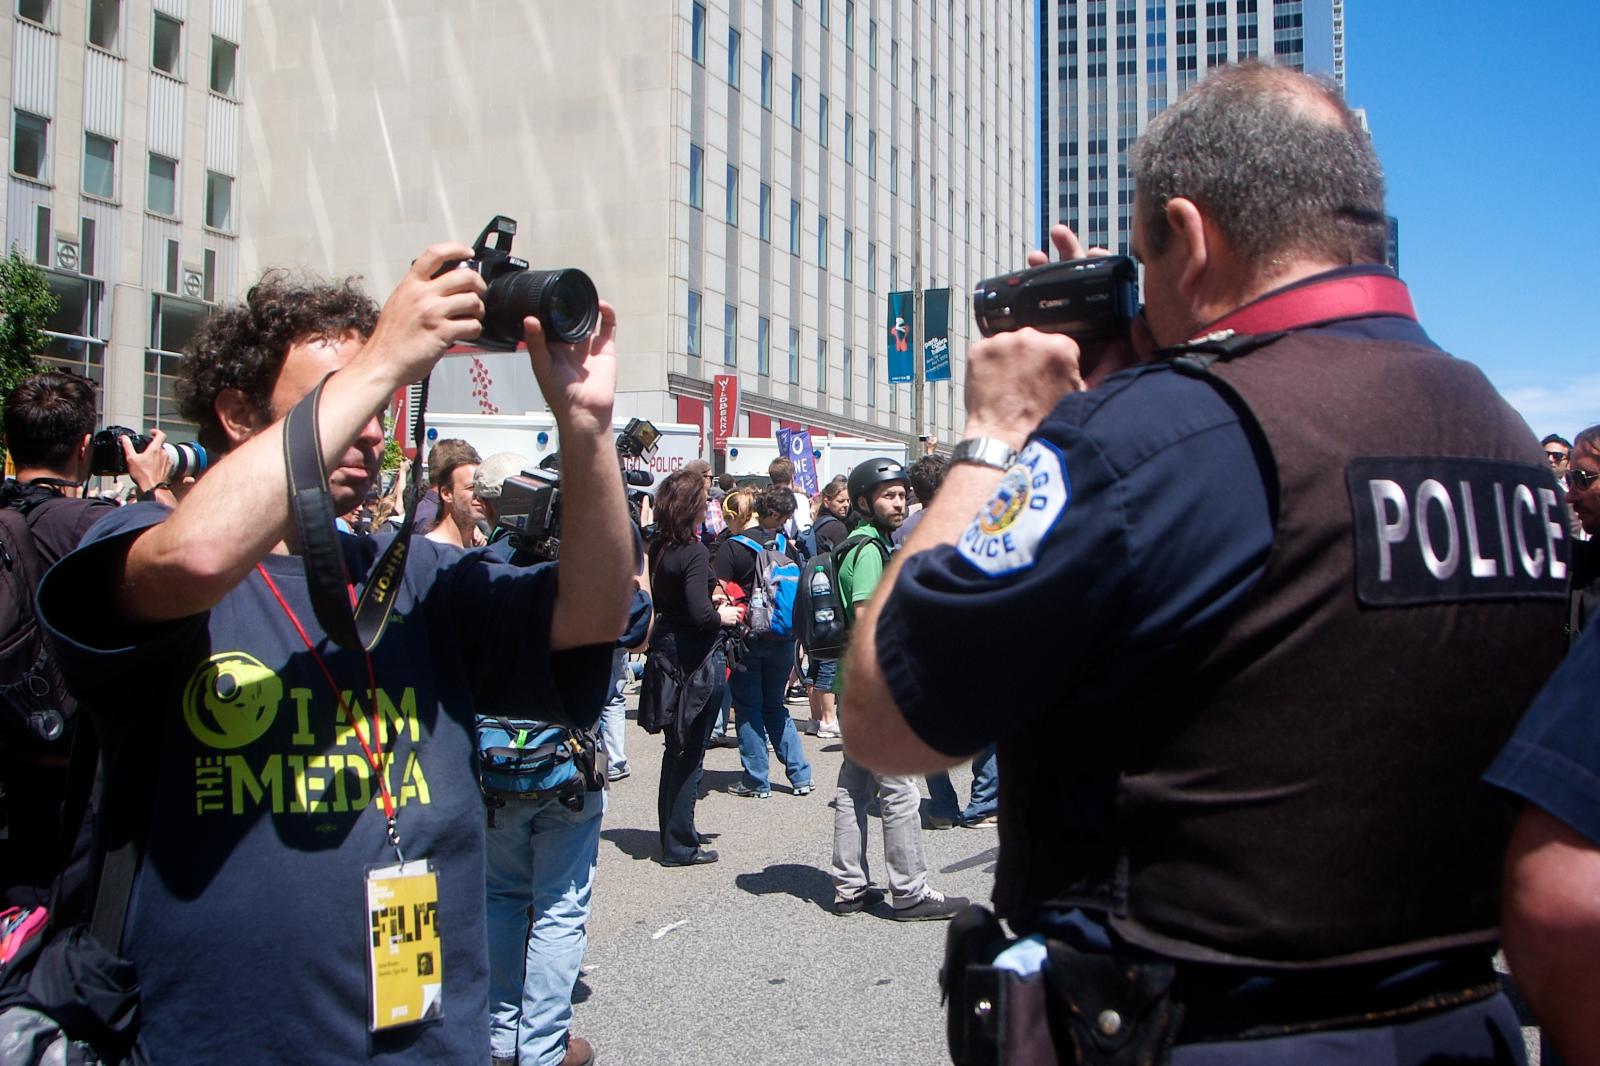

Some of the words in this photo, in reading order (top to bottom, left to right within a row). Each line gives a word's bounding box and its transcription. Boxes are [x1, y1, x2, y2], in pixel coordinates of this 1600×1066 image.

[649, 456, 684, 472] POLICE
[1369, 478, 1566, 582] POLICE
[290, 687, 315, 746] I
[335, 686, 420, 746] AM
[196, 755, 224, 816] THE
[224, 752, 431, 815] MEDIA
